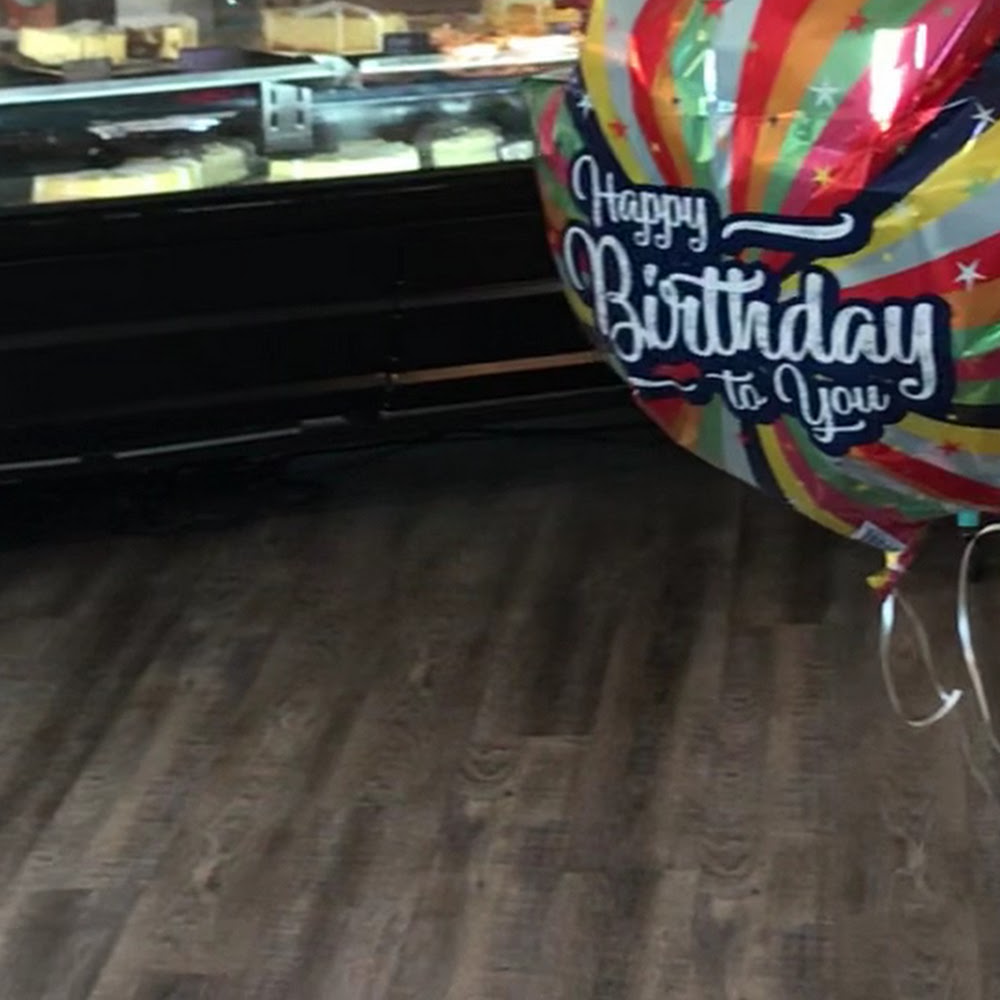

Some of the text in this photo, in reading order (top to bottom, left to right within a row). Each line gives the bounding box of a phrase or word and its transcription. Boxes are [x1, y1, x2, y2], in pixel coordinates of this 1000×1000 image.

[571, 154, 708, 252] Happy
[563, 226, 936, 400] Birthday
[705, 363, 891, 444] to You
